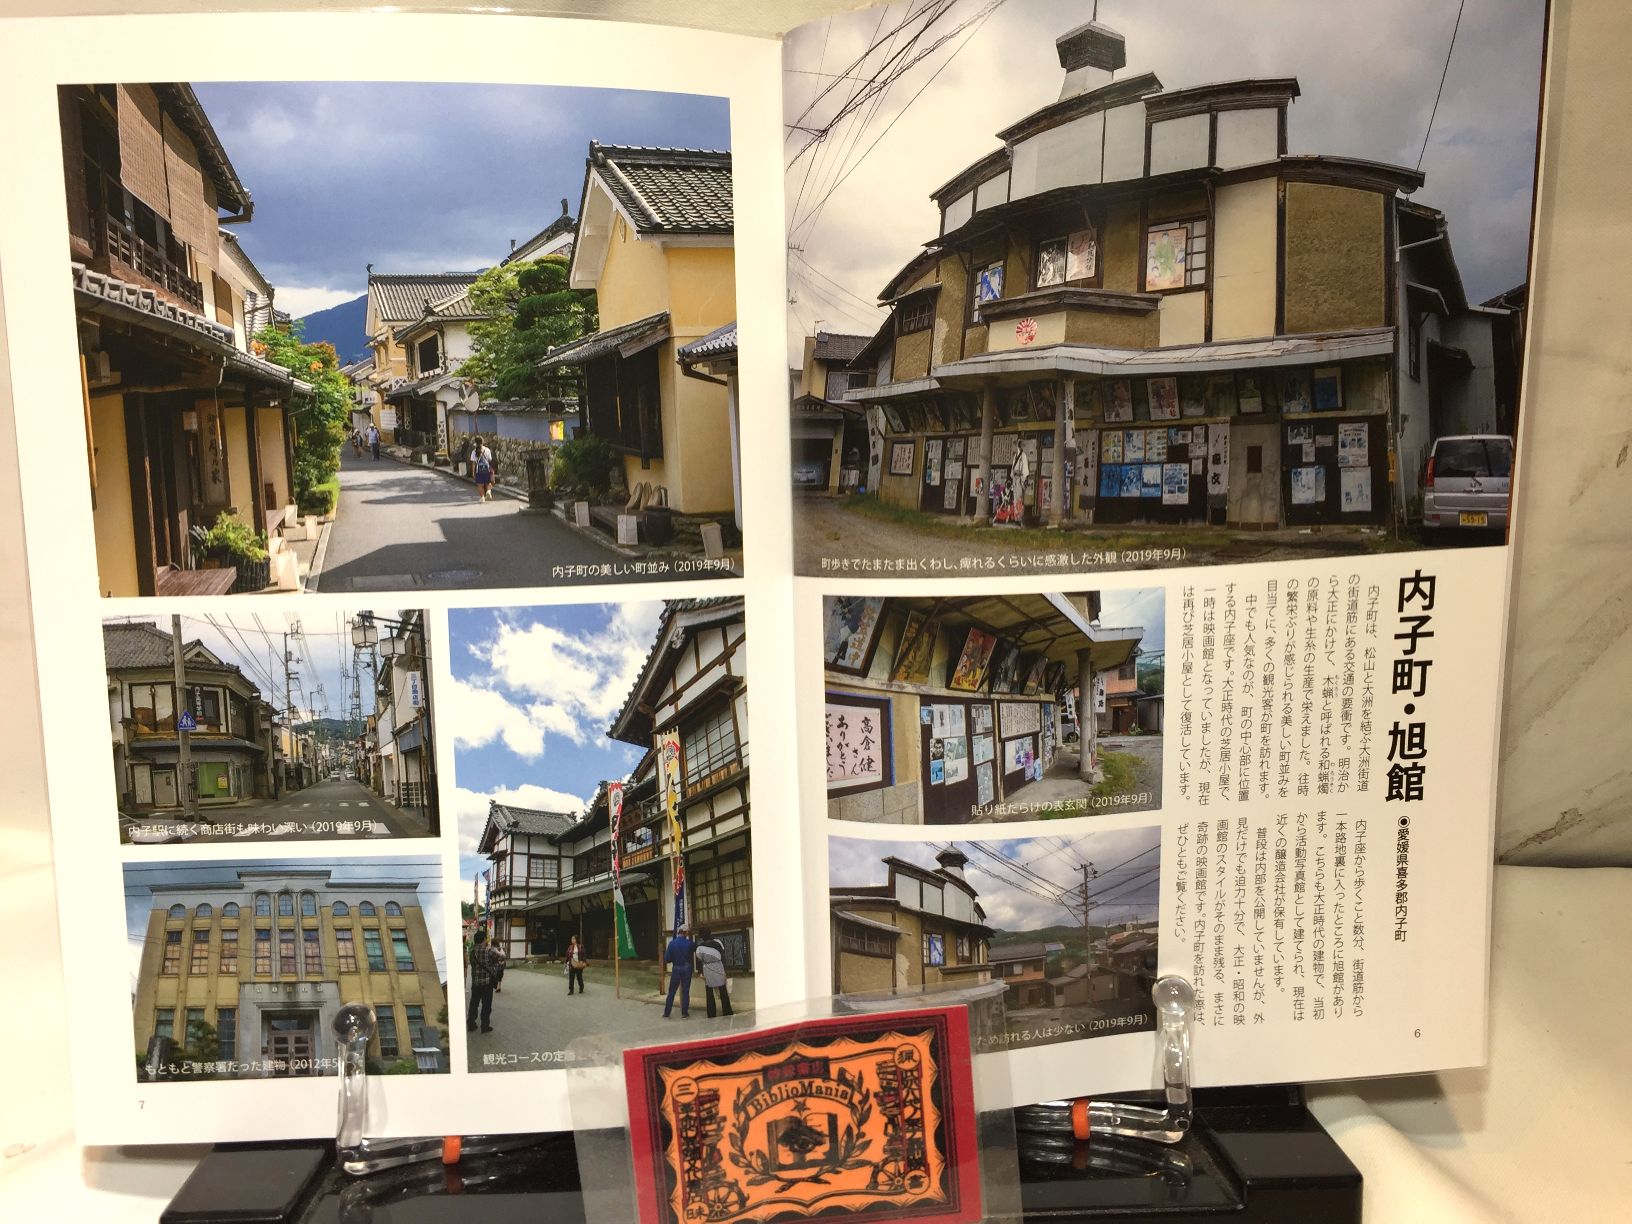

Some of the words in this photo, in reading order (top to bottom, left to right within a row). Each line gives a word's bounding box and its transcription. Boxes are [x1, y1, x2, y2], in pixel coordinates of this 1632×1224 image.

[552, 558, 735, 578] 内子町の美しい町並み（2019年9月）
[1179, 585, 1195, 801] は再び芝居小屋として復活しています。
[1198, 589, 1216, 806] 一時は映画館となっていましたが、現在
[1219, 582, 1236, 801] する内子座です。大正時代の芝居小屋で、
[1238, 594, 1257, 801] 中でも人気なのが、町の中心部に位置
[1259, 580, 1277, 799] 目当てに、多くの観光客が町を訪れます。
[1278, 579, 1299, 797] の繁栄ぶりが感じられる美しい町並みを
[1298, 577, 1319, 796] の原料や生糸の生産で栄えました。往時
[1337, 574, 1360, 792] の街道筋にある交通の要衝です。明治か
[1357, 584, 1379, 792] 内子町は、松山と大洲を結ぶ大洲街道
[1385, 569, 1436, 802] 内子町・旭館
[128, 820, 378, 836] 内子駅に続く商店街も味わい深い（2019年9月）
[971, 792, 1154, 817] 貼り紙だらけの表玄関（2019年9月）
[1175, 823, 1189, 942] ぜひともご覧ください。
[1273, 814, 1288, 993] 近くの醸造会社が保有しています。
[1194, 822, 1208, 1026] 奇跡の映画館です。内子町を訪れた際は、
[1214, 820, 1228, 1026] 画館のスタイルがそのまま残る、まさに
[1234, 817, 1248, 1025] 見だけでも迫力十分で、大正・昭和の映
[1253, 828, 1267, 1023] 普段は内部を公開していませんが、外
[1293, 813, 1308, 1020] から活動写真館として建てられ、現在は
[1313, 811, 1327, 1020] ます。こちらも大正時代の建物で、当初
[1333, 814, 1347, 1018] 一本路地裏に入ったところに旭館があり
[1352, 819, 1367, 1016] 内子座から歩くこと数分、街道筋から
[138, 1100, 145, 1110] 7
[748, 1080, 850, 1115] BiblioMania
[1414, 1028, 1421, 1038] 6
